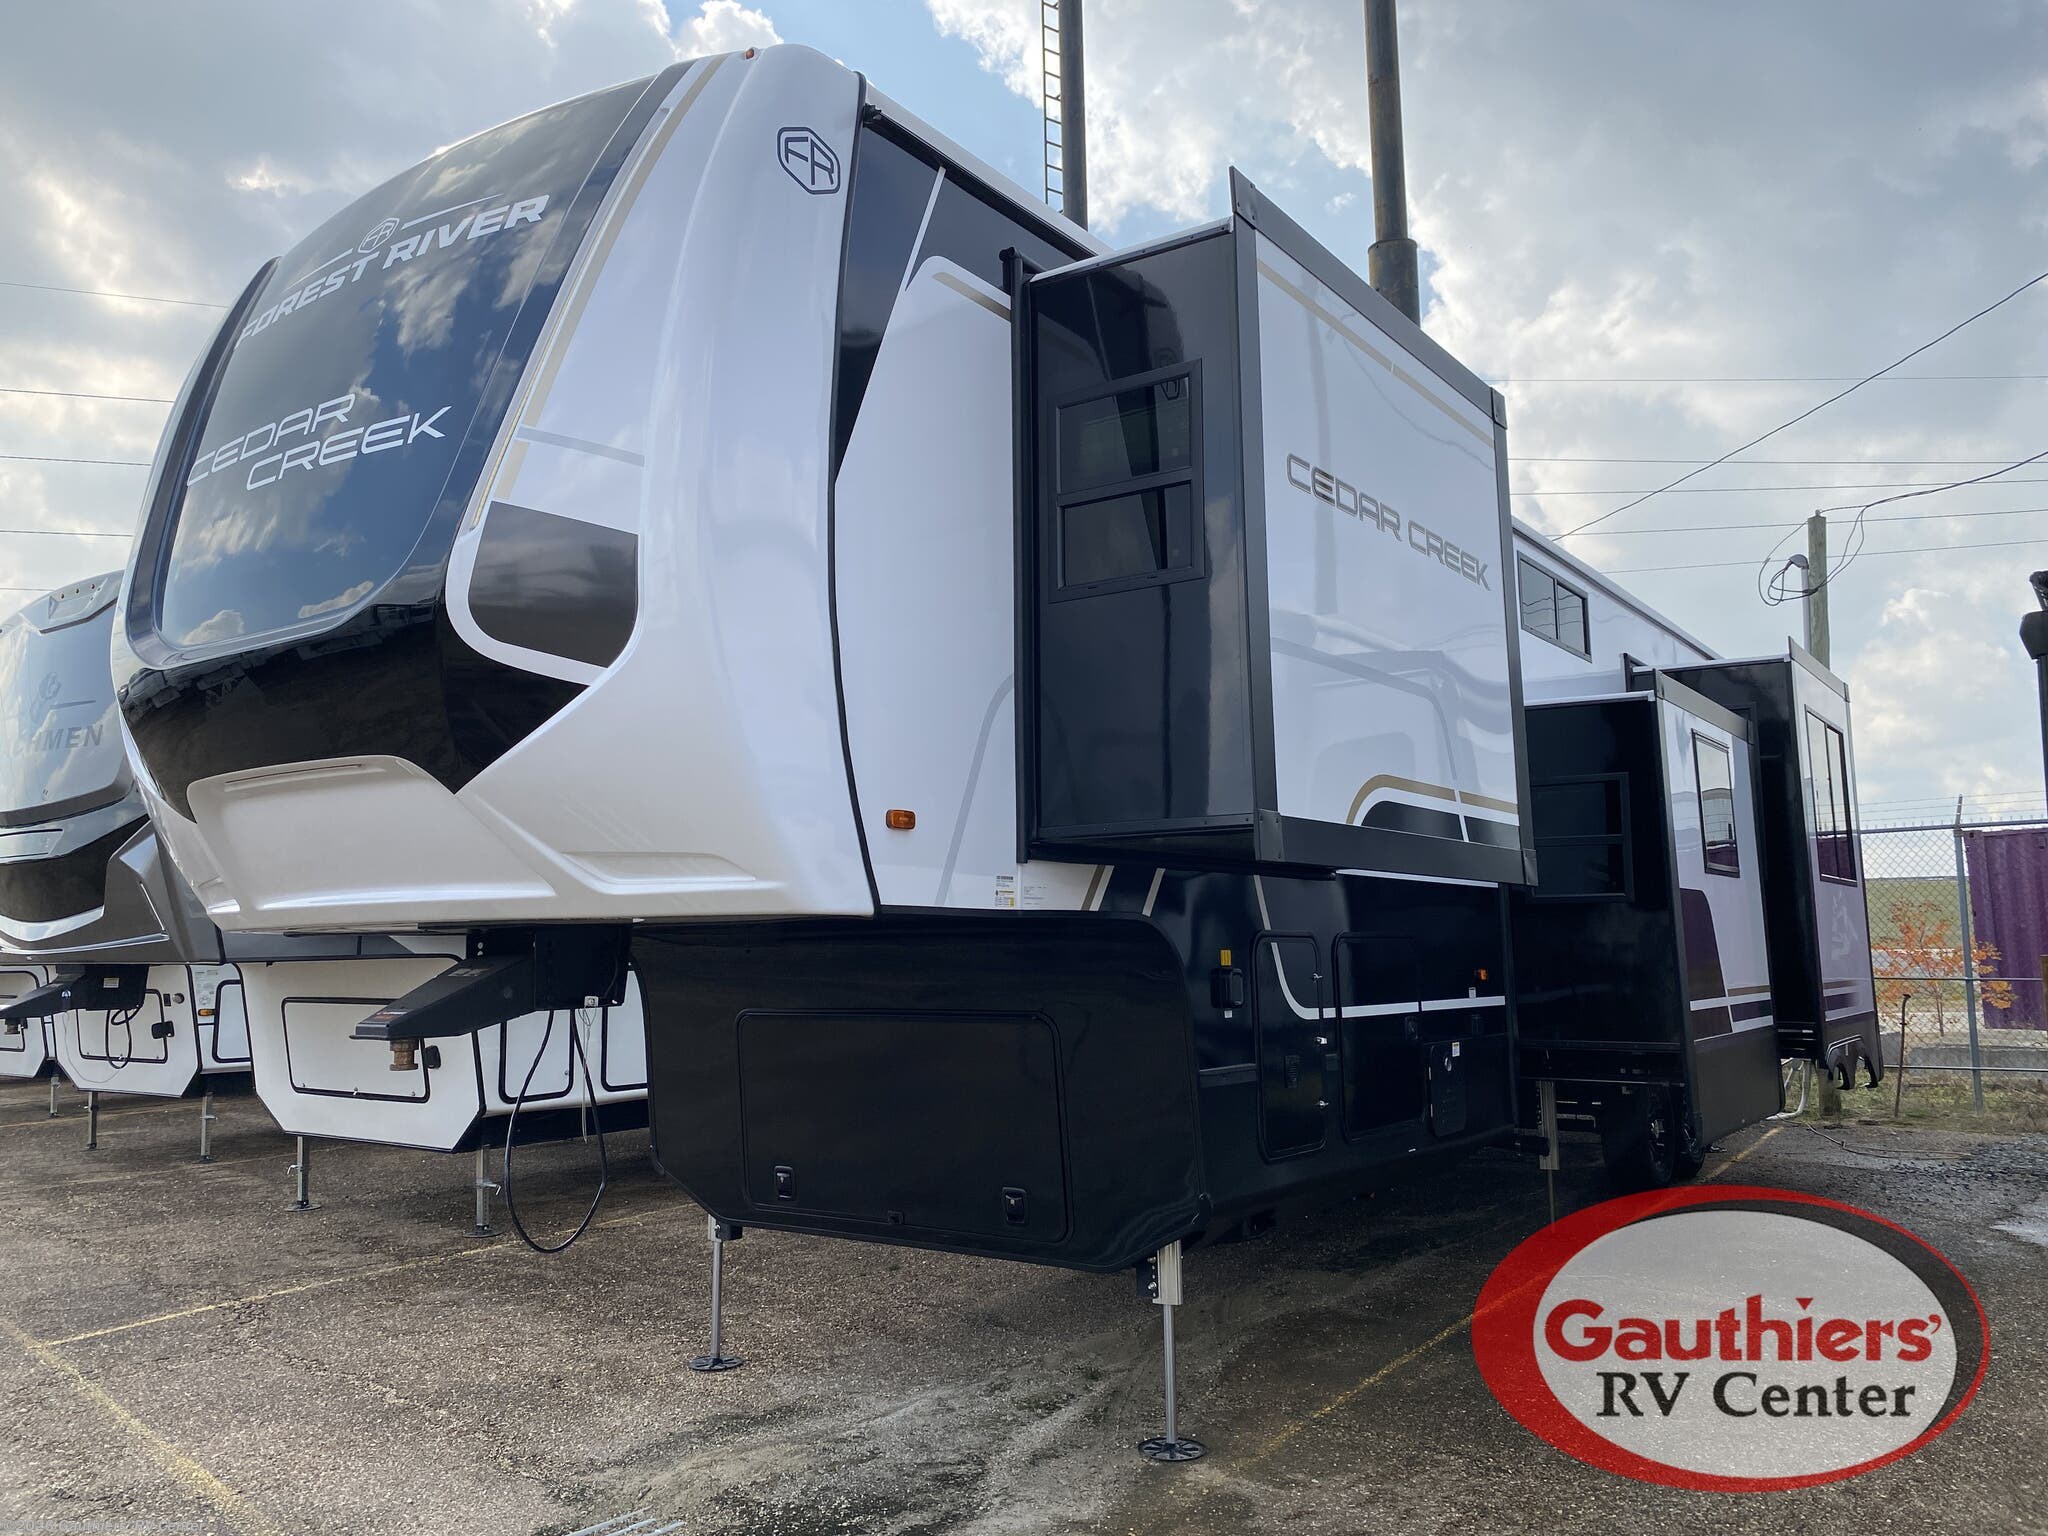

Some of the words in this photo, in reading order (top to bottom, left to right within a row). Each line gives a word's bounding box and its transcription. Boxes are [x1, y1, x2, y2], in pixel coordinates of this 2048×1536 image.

[235, 252, 379, 347] FOREST
[382, 195, 550, 271] RIVER
[187, 393, 356, 487] CEDAR
[246, 405, 453, 491] CREEK
[1286, 452, 1403, 543] CEDAR
[1407, 518, 1491, 592] CREEK
